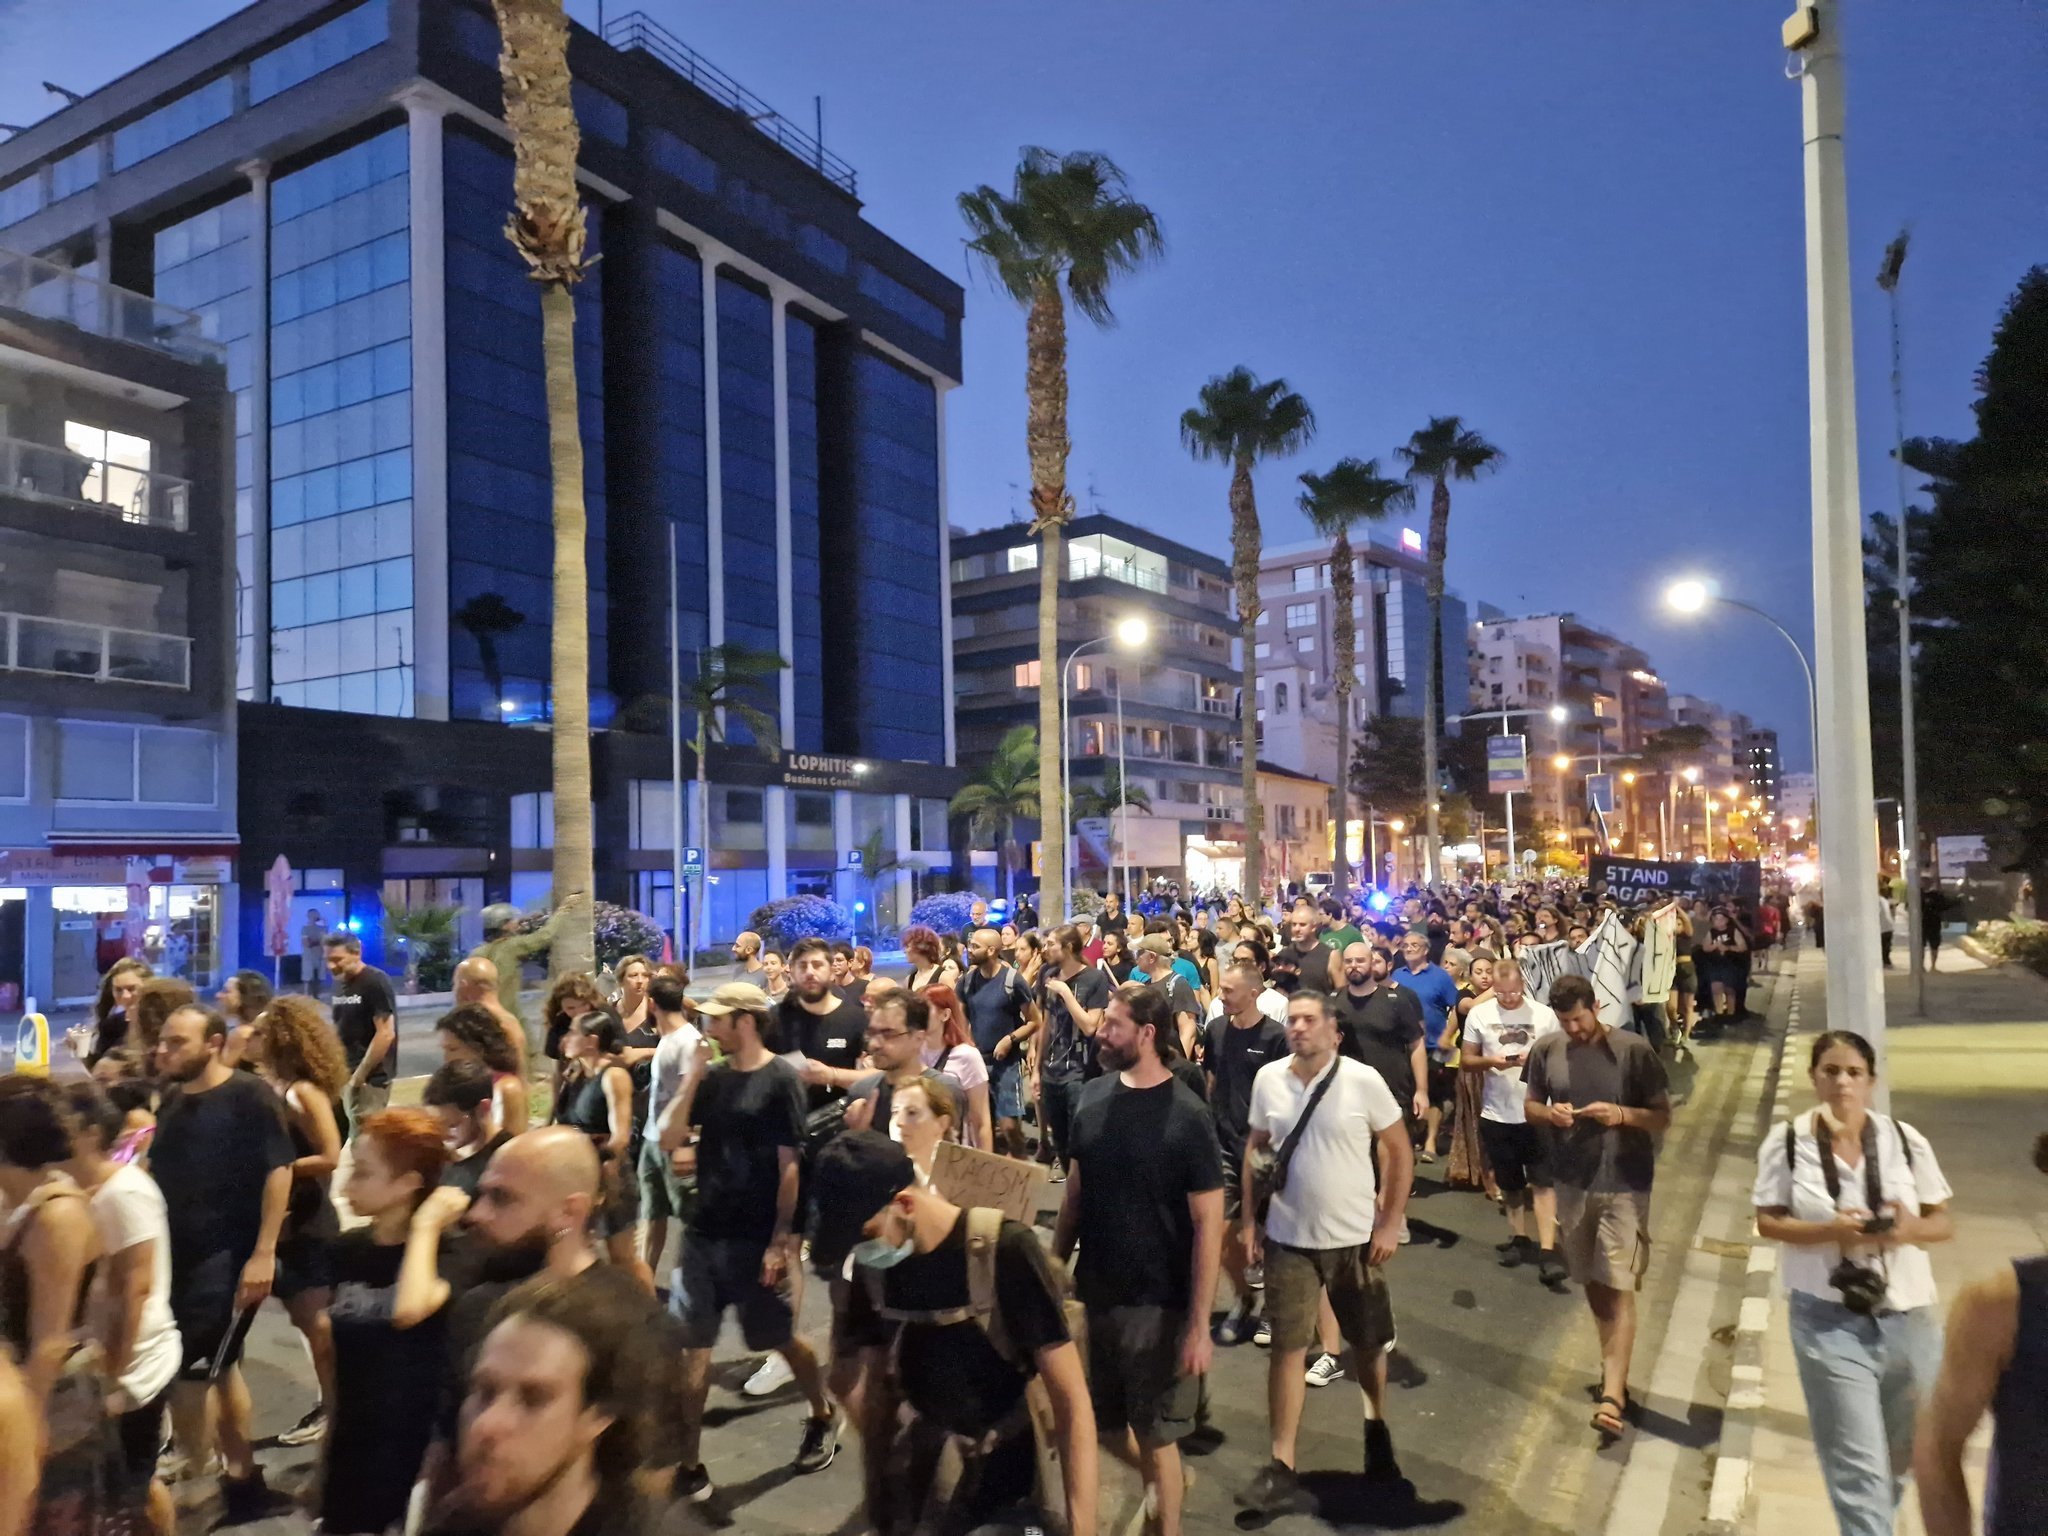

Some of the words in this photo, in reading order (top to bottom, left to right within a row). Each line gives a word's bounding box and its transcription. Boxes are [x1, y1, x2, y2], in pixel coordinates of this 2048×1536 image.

[789, 754, 855, 774] LOPHITIS
[784, 773, 828, 786] Business
[687, 849, 698, 863] P
[850, 852, 860, 862] P
[1605, 866, 1669, 885] STAND
[943, 1145, 1032, 1205] RACISM
